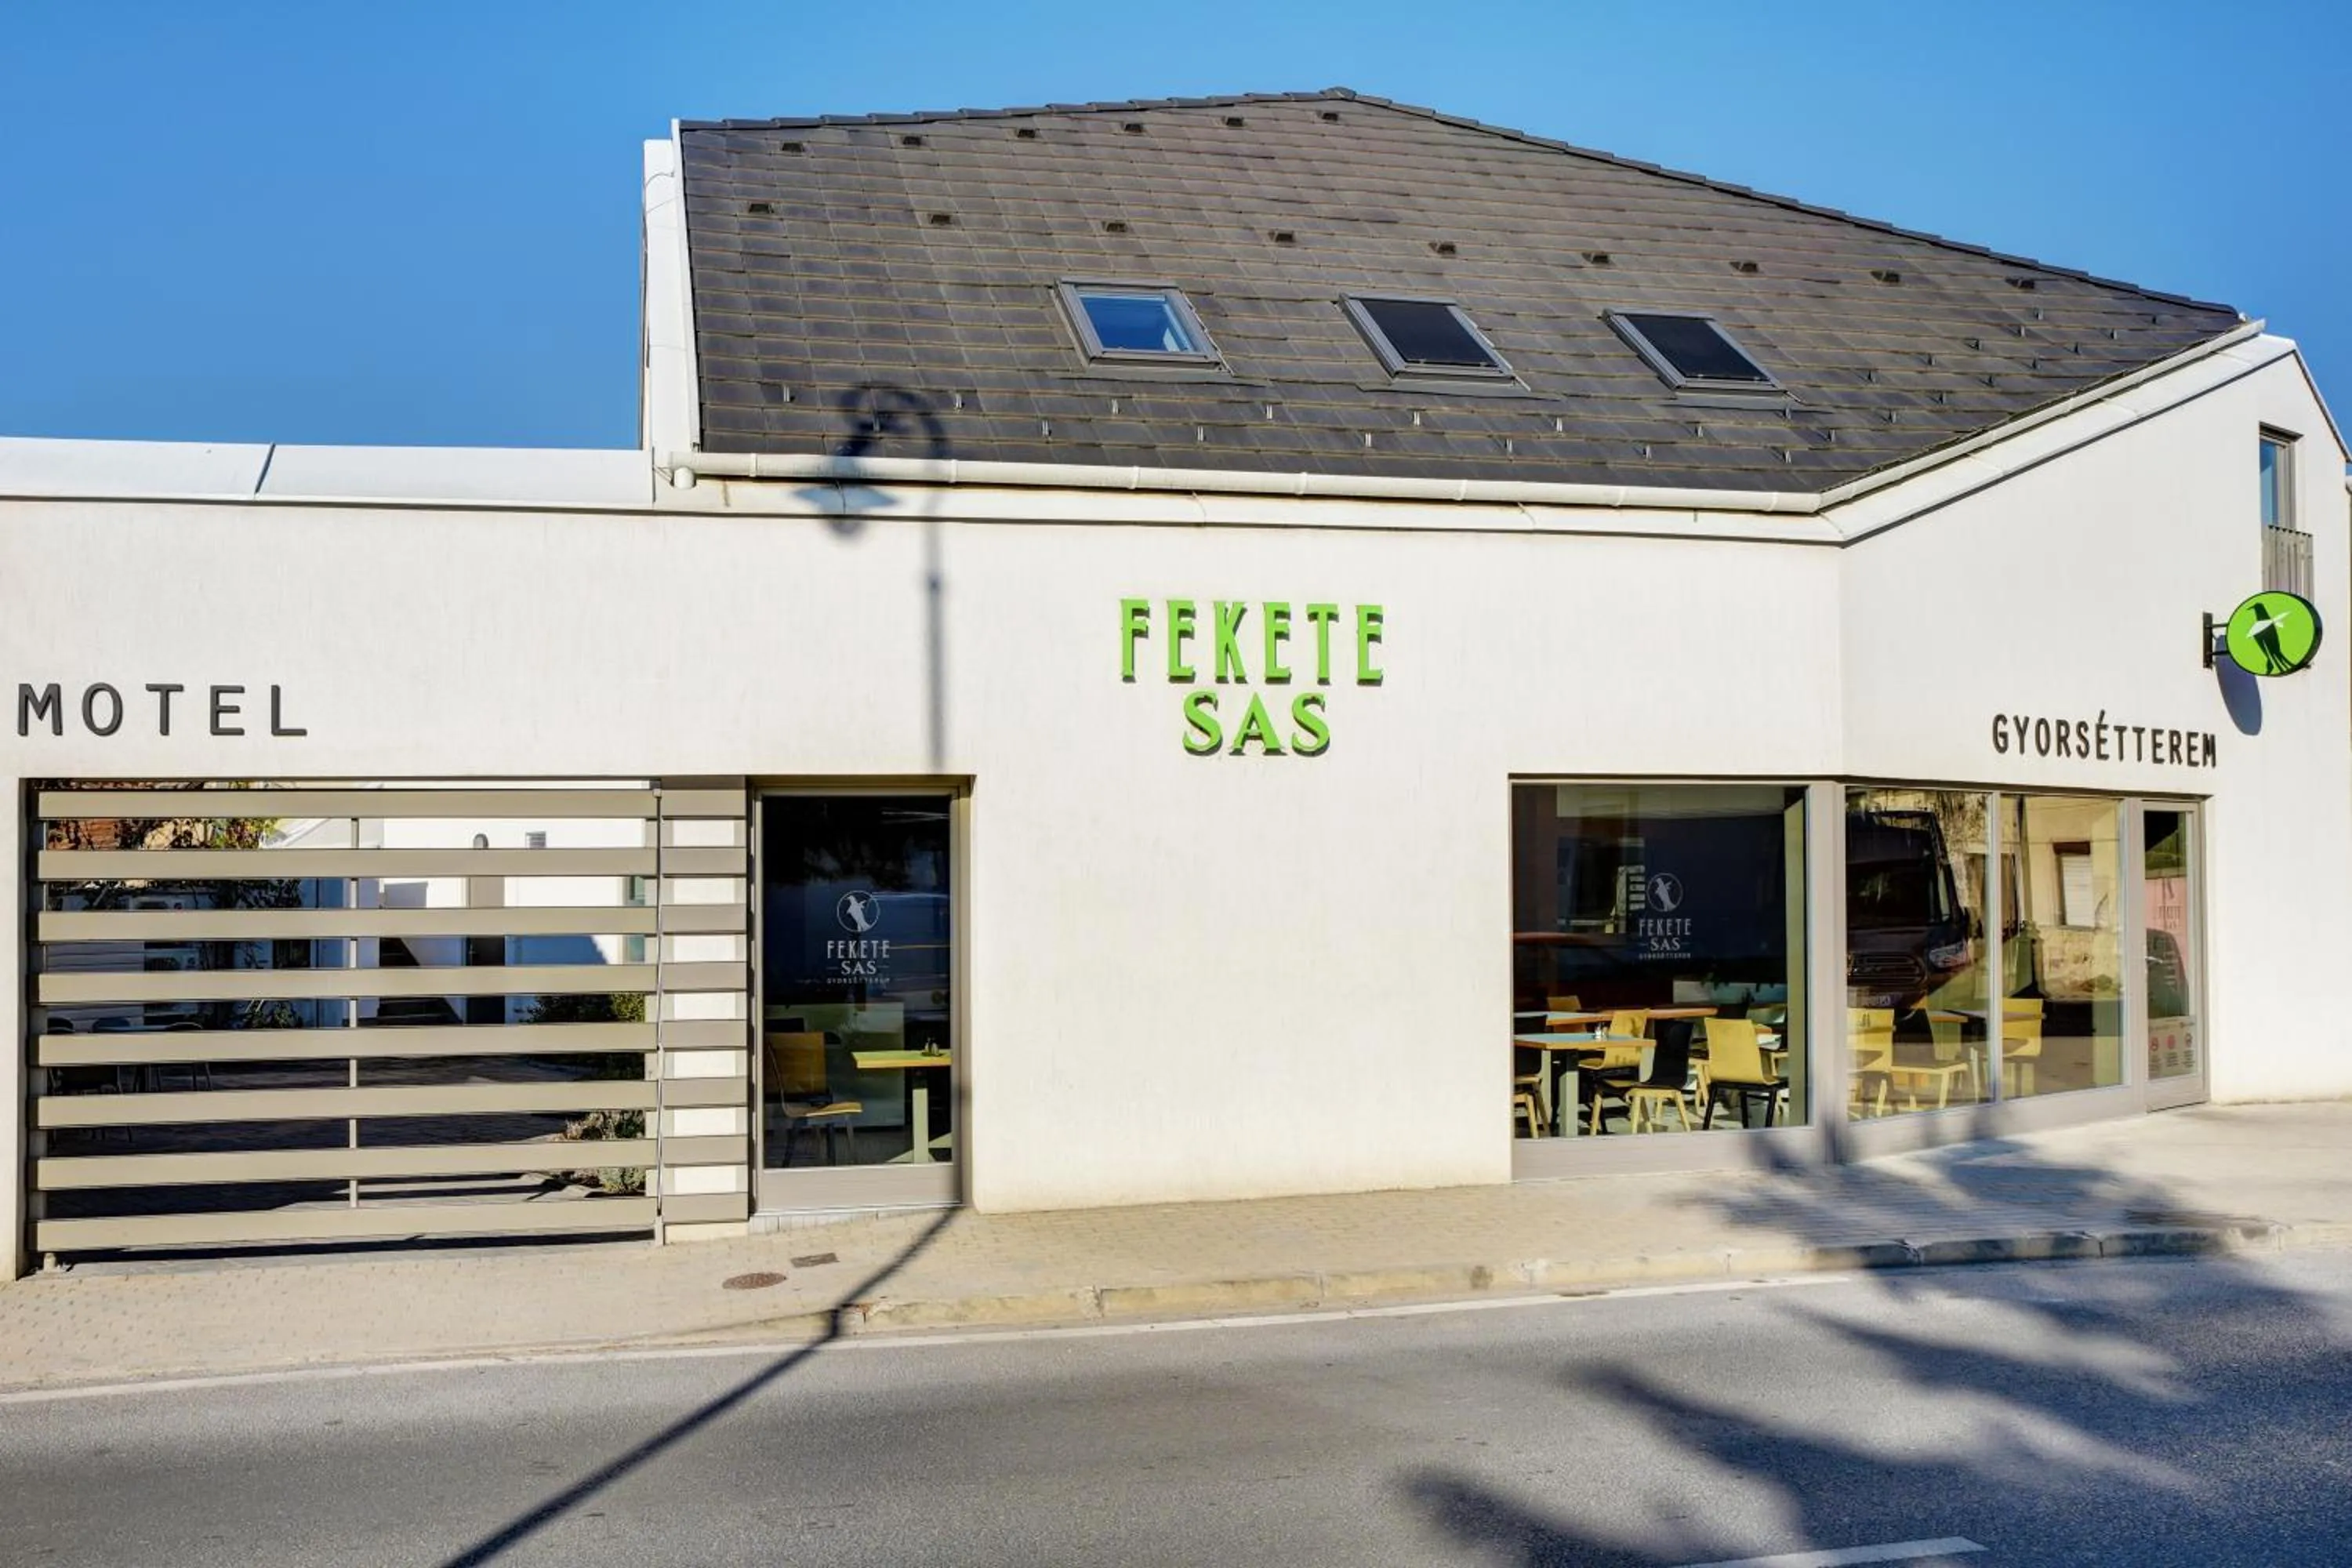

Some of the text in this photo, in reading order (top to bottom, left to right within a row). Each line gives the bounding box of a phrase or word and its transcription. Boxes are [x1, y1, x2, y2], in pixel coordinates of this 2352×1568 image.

[1120, 598, 1384, 687] FEKETE
[17, 682, 308, 736] MOTEL
[1182, 690, 1331, 757] SAS
[1992, 709, 2217, 768] GYORSÉTTEREM
[1639, 918, 1692, 937] FEKETE
[1650, 937, 1681, 951] SAS
[827, 940, 890, 959] FEKETE
[841, 960, 877, 975] SAS
